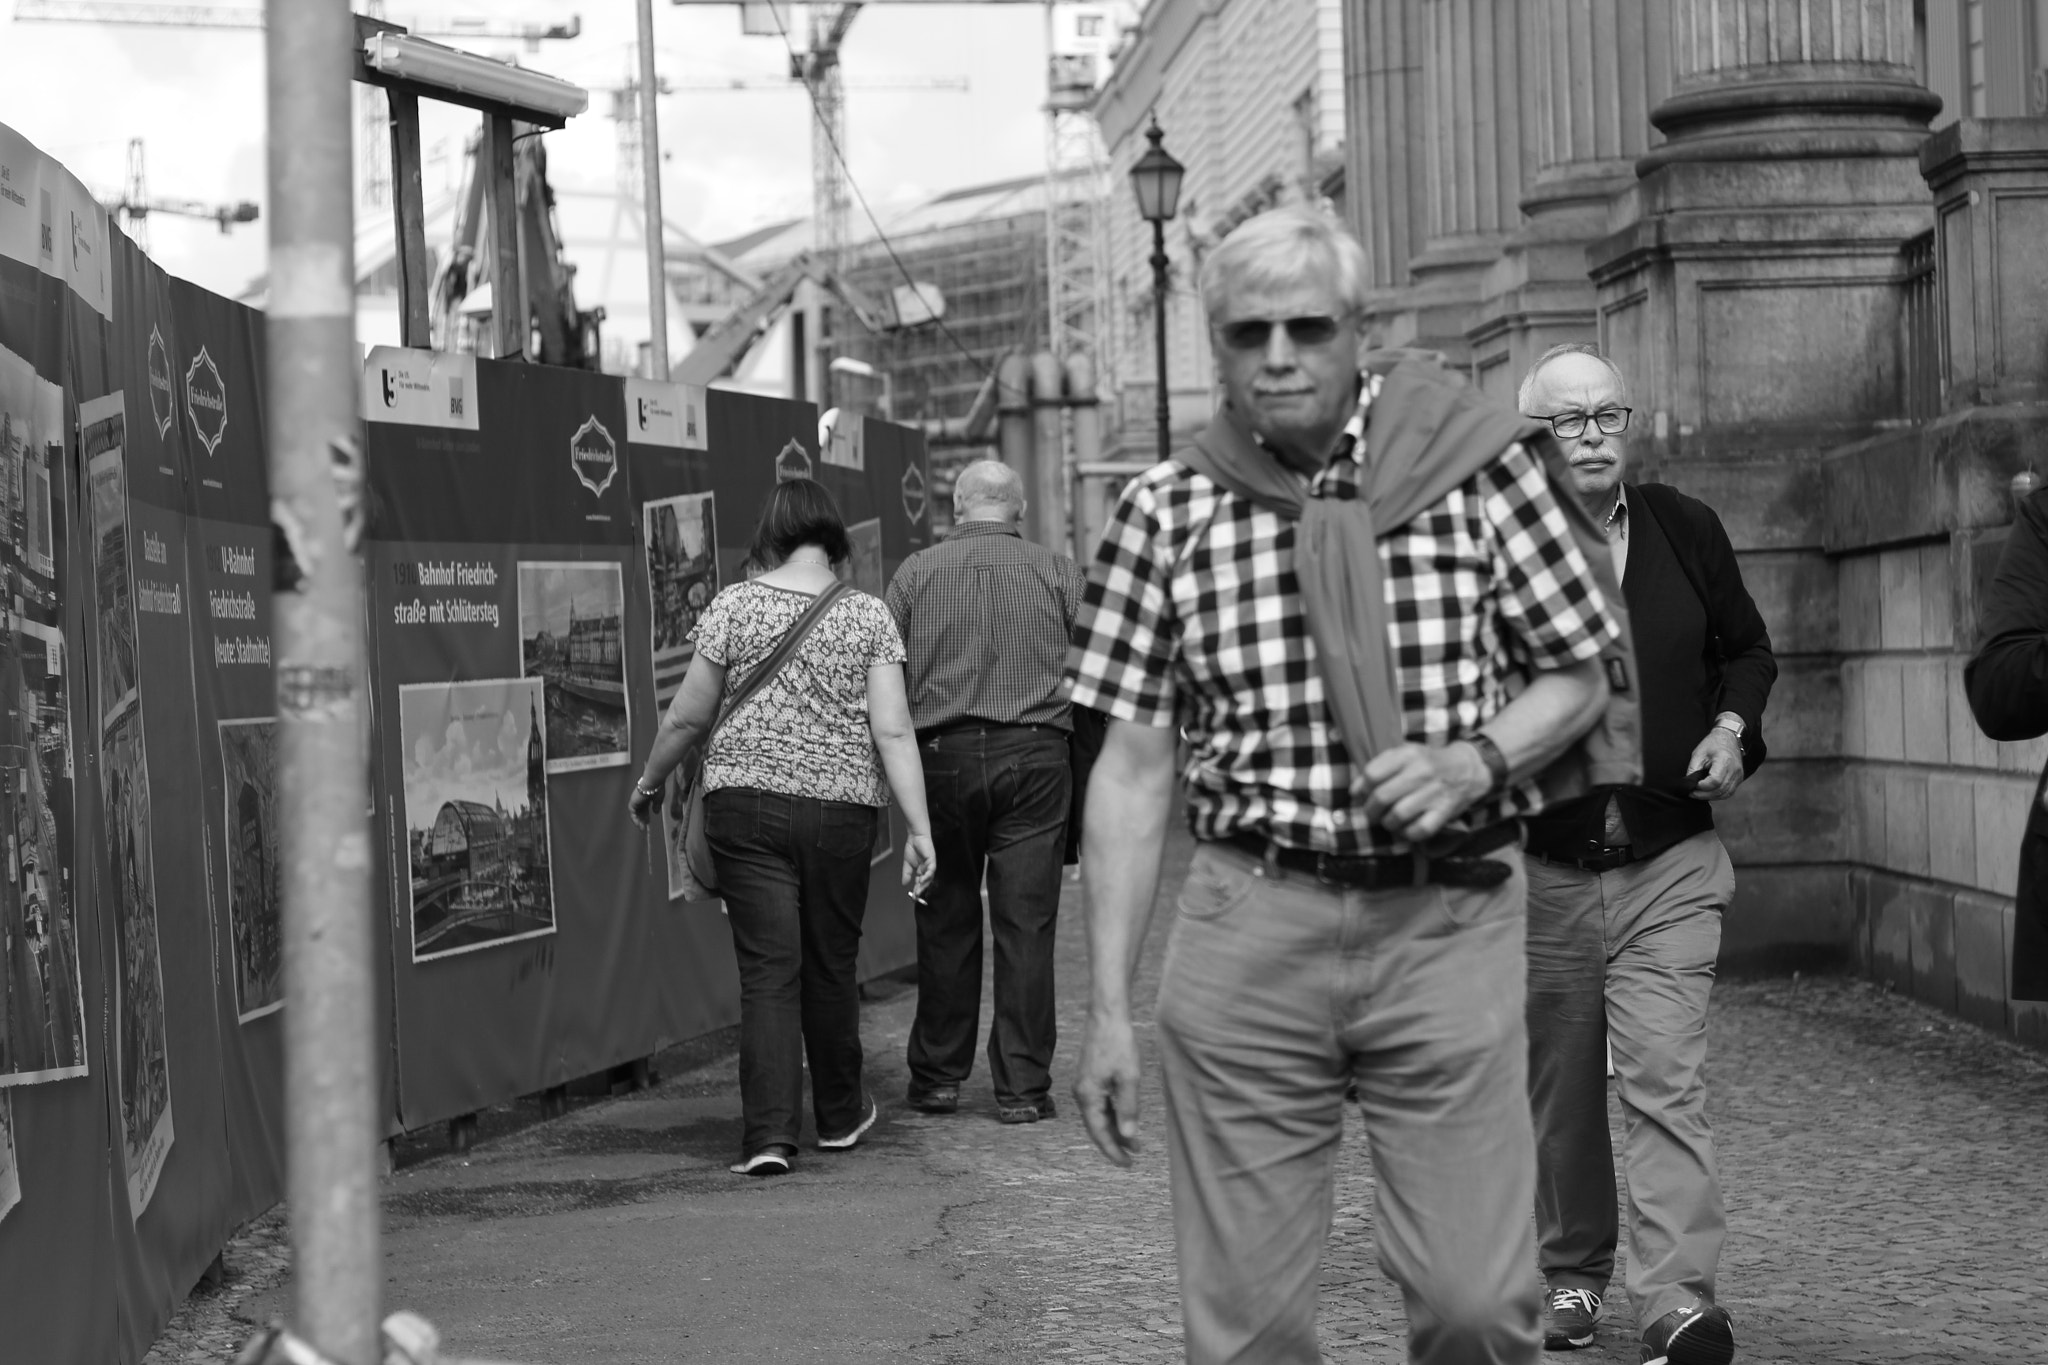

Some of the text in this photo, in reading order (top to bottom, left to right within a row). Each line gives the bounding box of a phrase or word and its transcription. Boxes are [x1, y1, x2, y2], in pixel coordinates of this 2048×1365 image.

[450, 397, 463, 415] BVG
[221, 546, 255, 576] U-Bahnhof
[393, 560, 498, 586] 1910 Bahnhof Friedrich-
[209, 589, 256, 620] Friedrichstraße
[394, 598, 499, 628] straße mit Schlütersteg
[236, 634, 271, 669] Stadtmitte)
